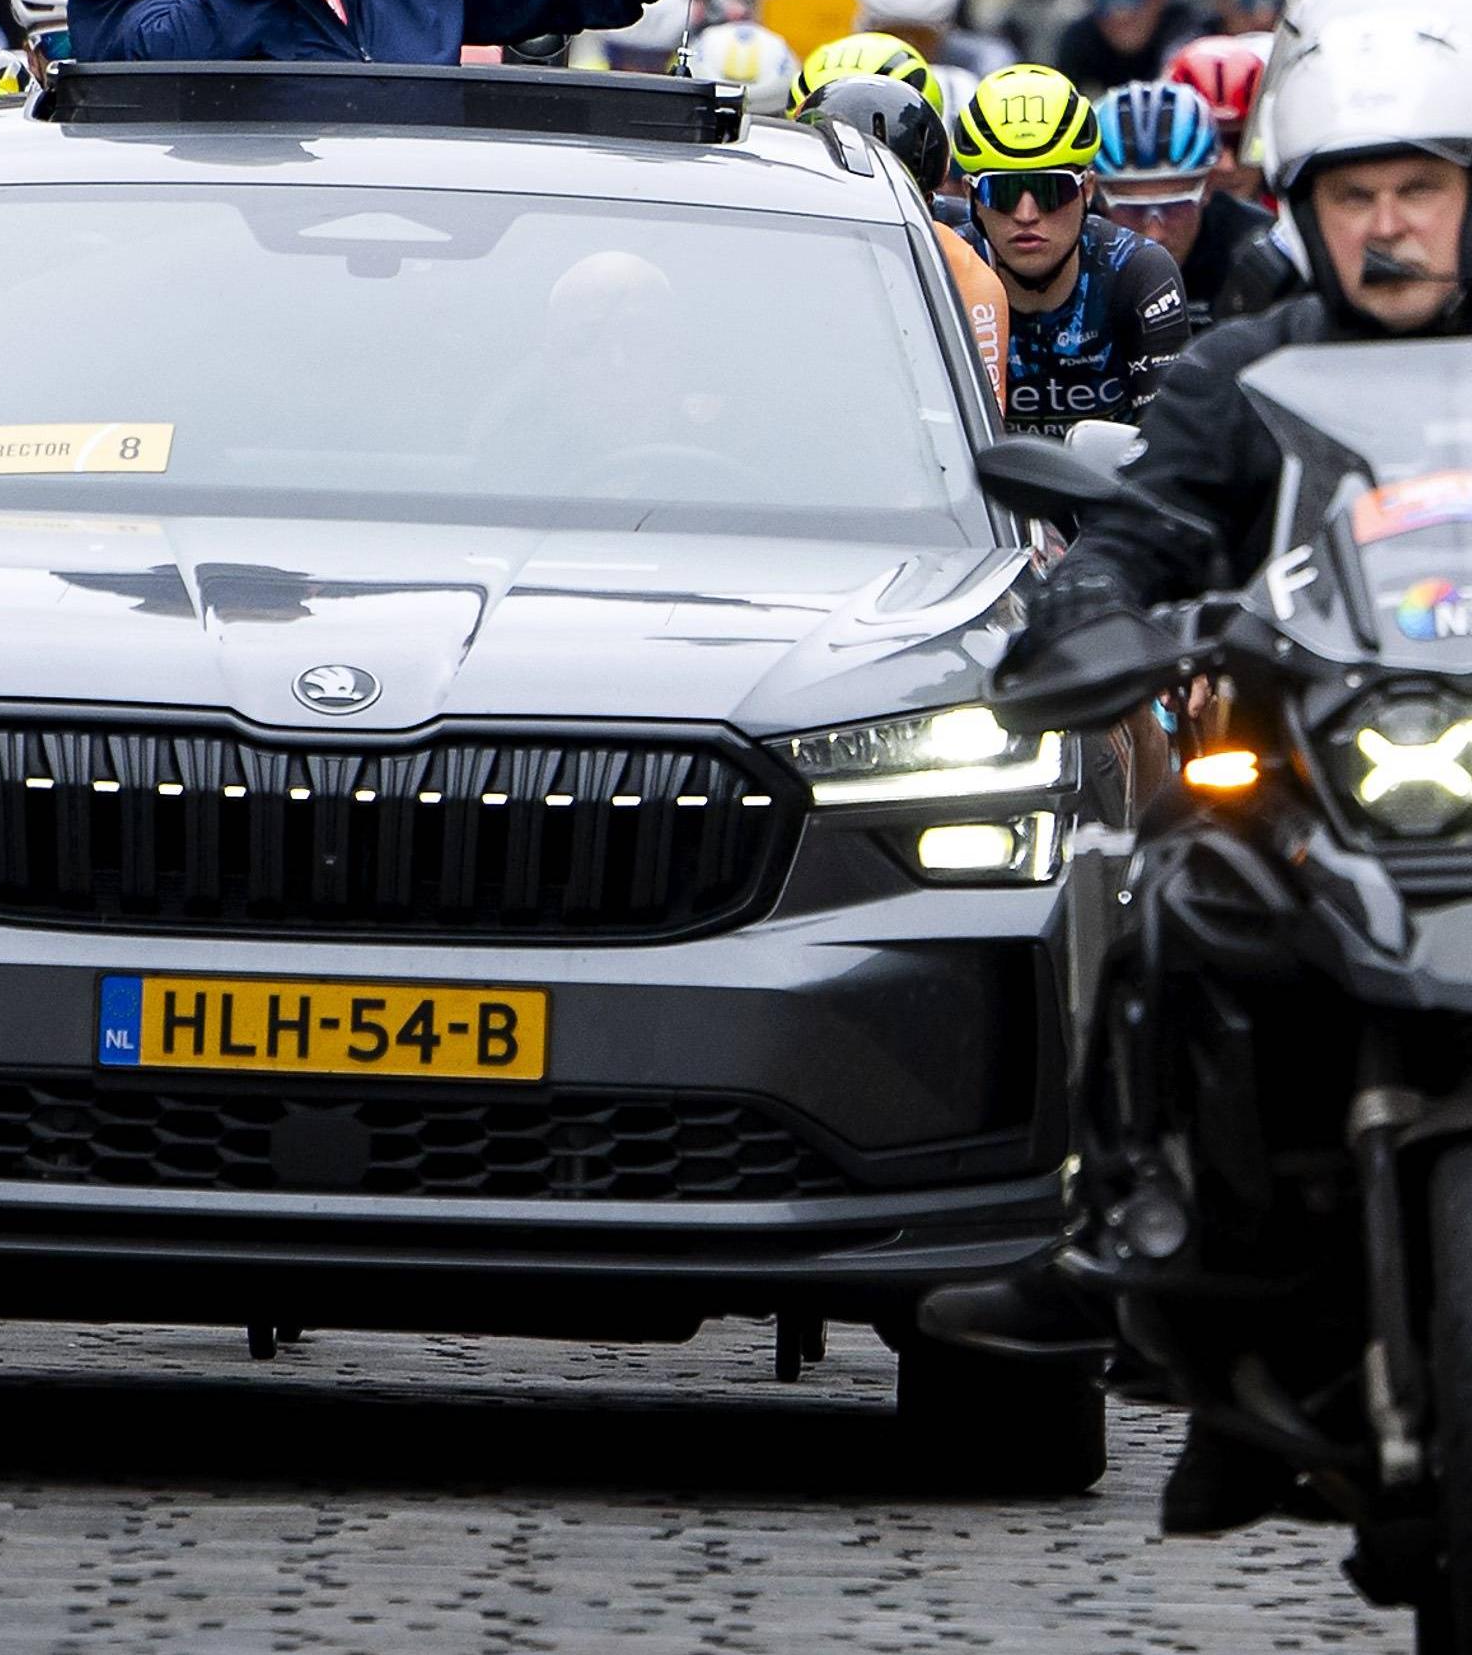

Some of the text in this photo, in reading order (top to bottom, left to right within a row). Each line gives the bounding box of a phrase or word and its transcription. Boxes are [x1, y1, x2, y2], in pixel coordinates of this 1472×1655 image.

[1011, 377, 1124, 413] etec
[119, 437, 141, 459] 8
[1266, 543, 1319, 620] F
[106, 990, 519, 1066] NL HLH-54-B
